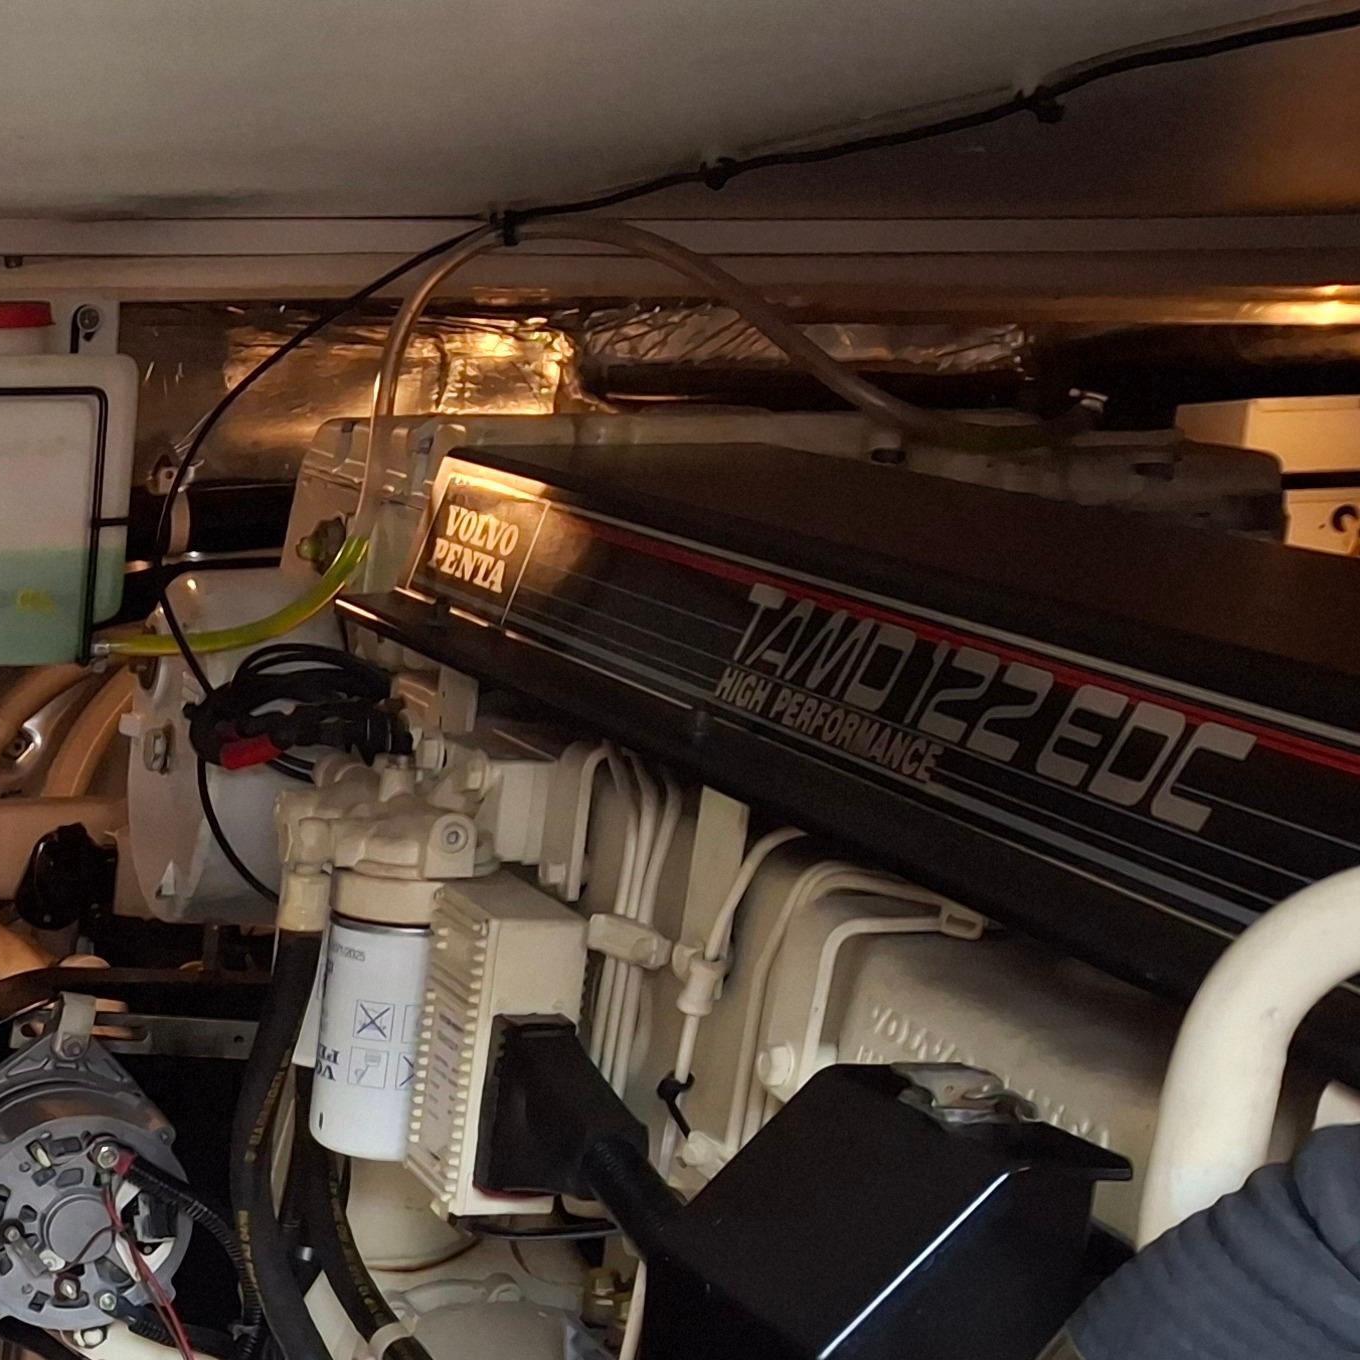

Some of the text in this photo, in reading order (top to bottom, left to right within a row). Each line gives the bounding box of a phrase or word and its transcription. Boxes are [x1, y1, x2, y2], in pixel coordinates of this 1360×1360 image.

[427, 537, 505, 594] PENTA
[446, 504, 519, 556] VOLVO
[715, 667, 944, 783] HIGH PERFORMANCE
[733, 582, 1257, 832] TAMD 122 EDC
